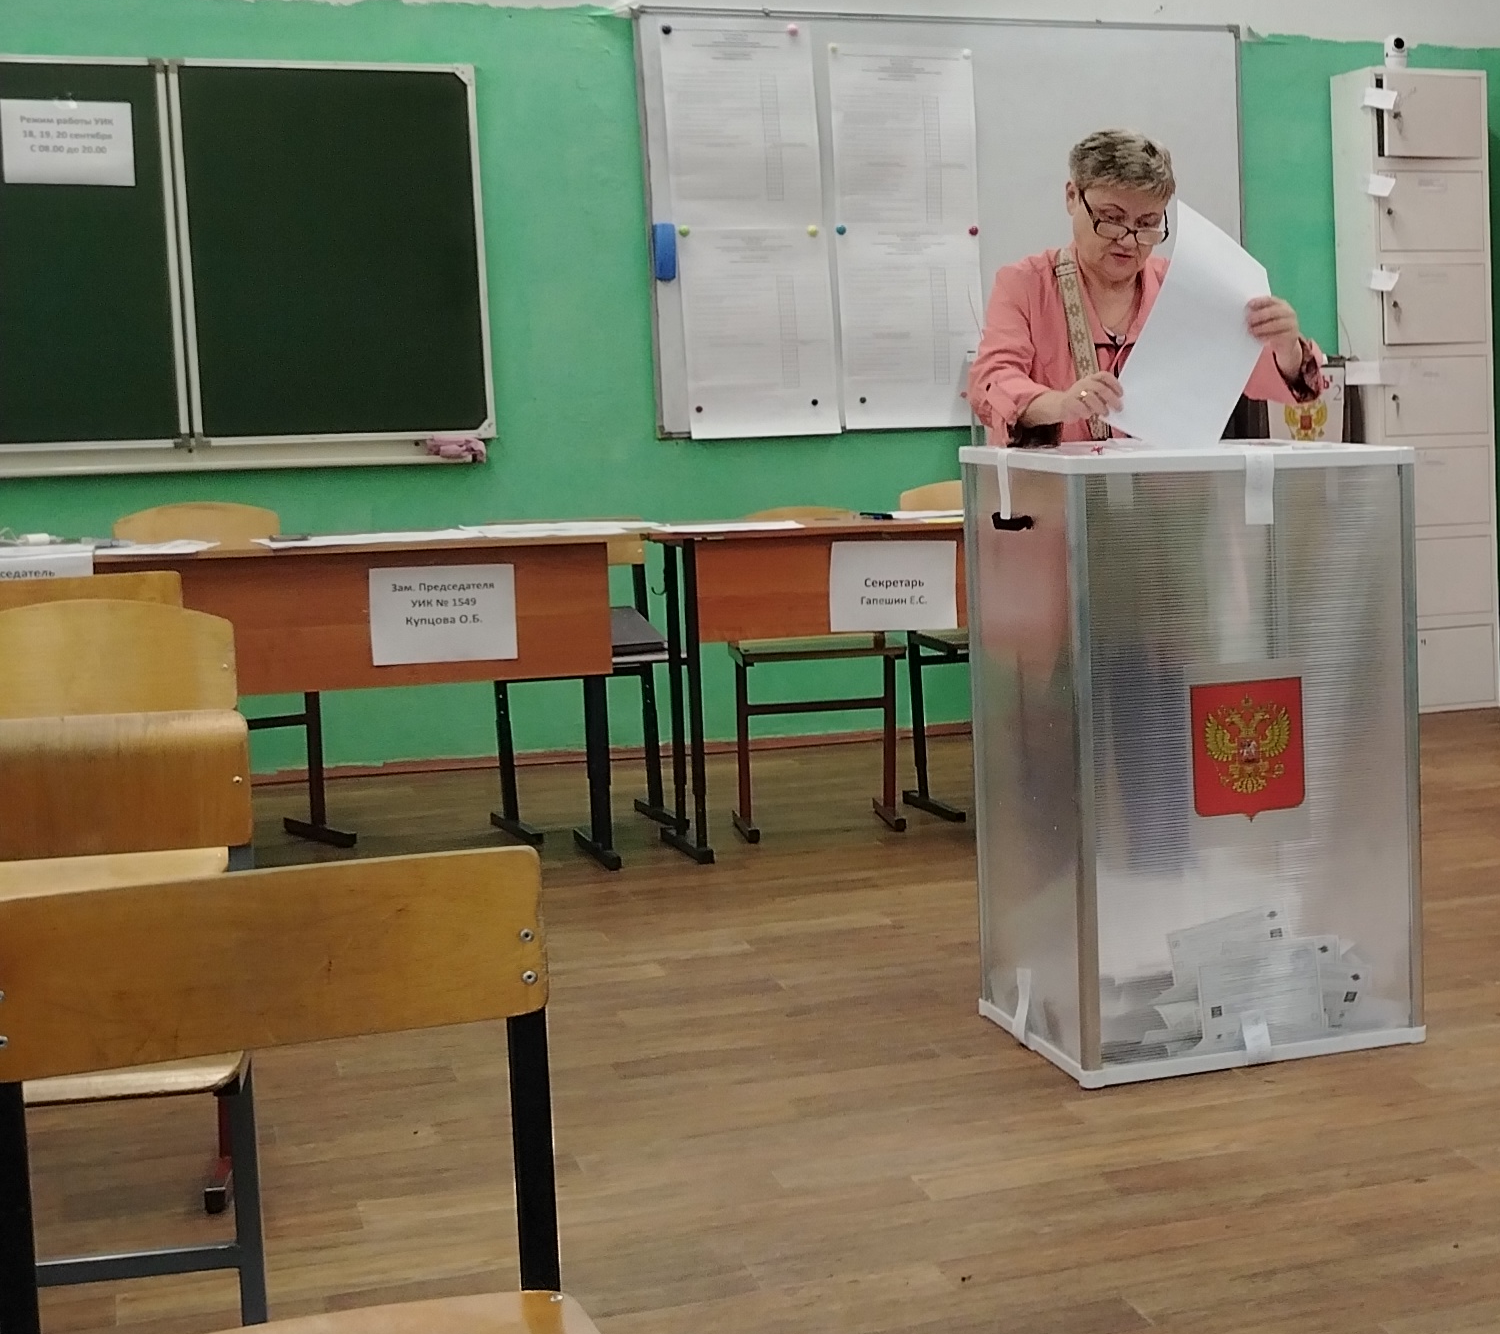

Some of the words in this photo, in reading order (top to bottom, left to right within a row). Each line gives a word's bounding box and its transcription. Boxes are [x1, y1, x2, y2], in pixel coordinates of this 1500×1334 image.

[56, 117, 92, 126] работы
[56, 130, 68, 139] 20
[69, 132, 113, 141] сентября
[66, 147, 80, 155] до
[391, 583, 416, 593] Зам.
[418, 582, 495, 593] Председателя
[863, 577, 925, 589] Секретарь
[410, 598, 434, 608] УИК
[436, 599, 449, 608] №
[452, 597, 477, 607] 1549
[405, 615, 456, 628] Купцова
[459, 613, 483, 625] О.Б.
